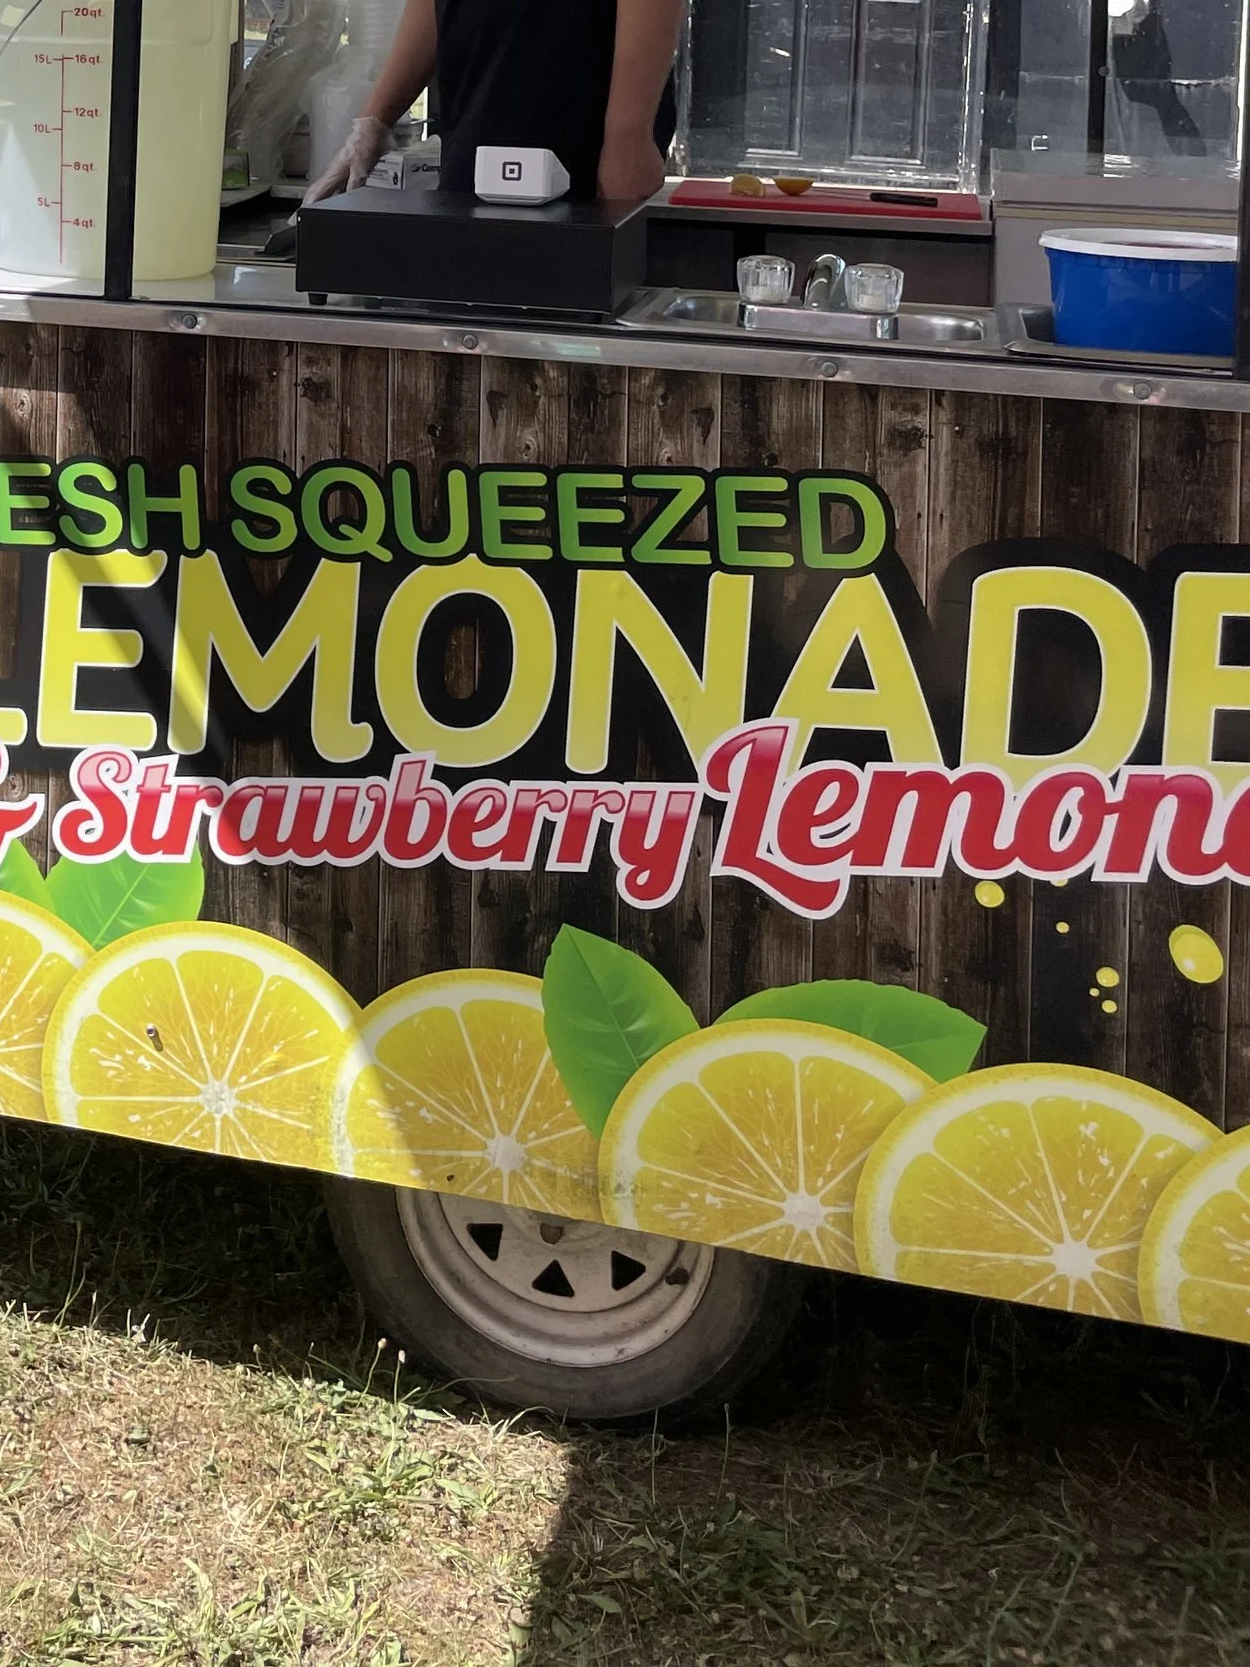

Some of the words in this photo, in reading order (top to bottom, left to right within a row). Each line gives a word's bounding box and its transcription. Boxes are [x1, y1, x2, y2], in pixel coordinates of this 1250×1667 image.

[228, 463, 889, 571] SQUEEZED
[53, 746, 701, 907] Strawberry
[703, 721, 1250, 916] Lemon
